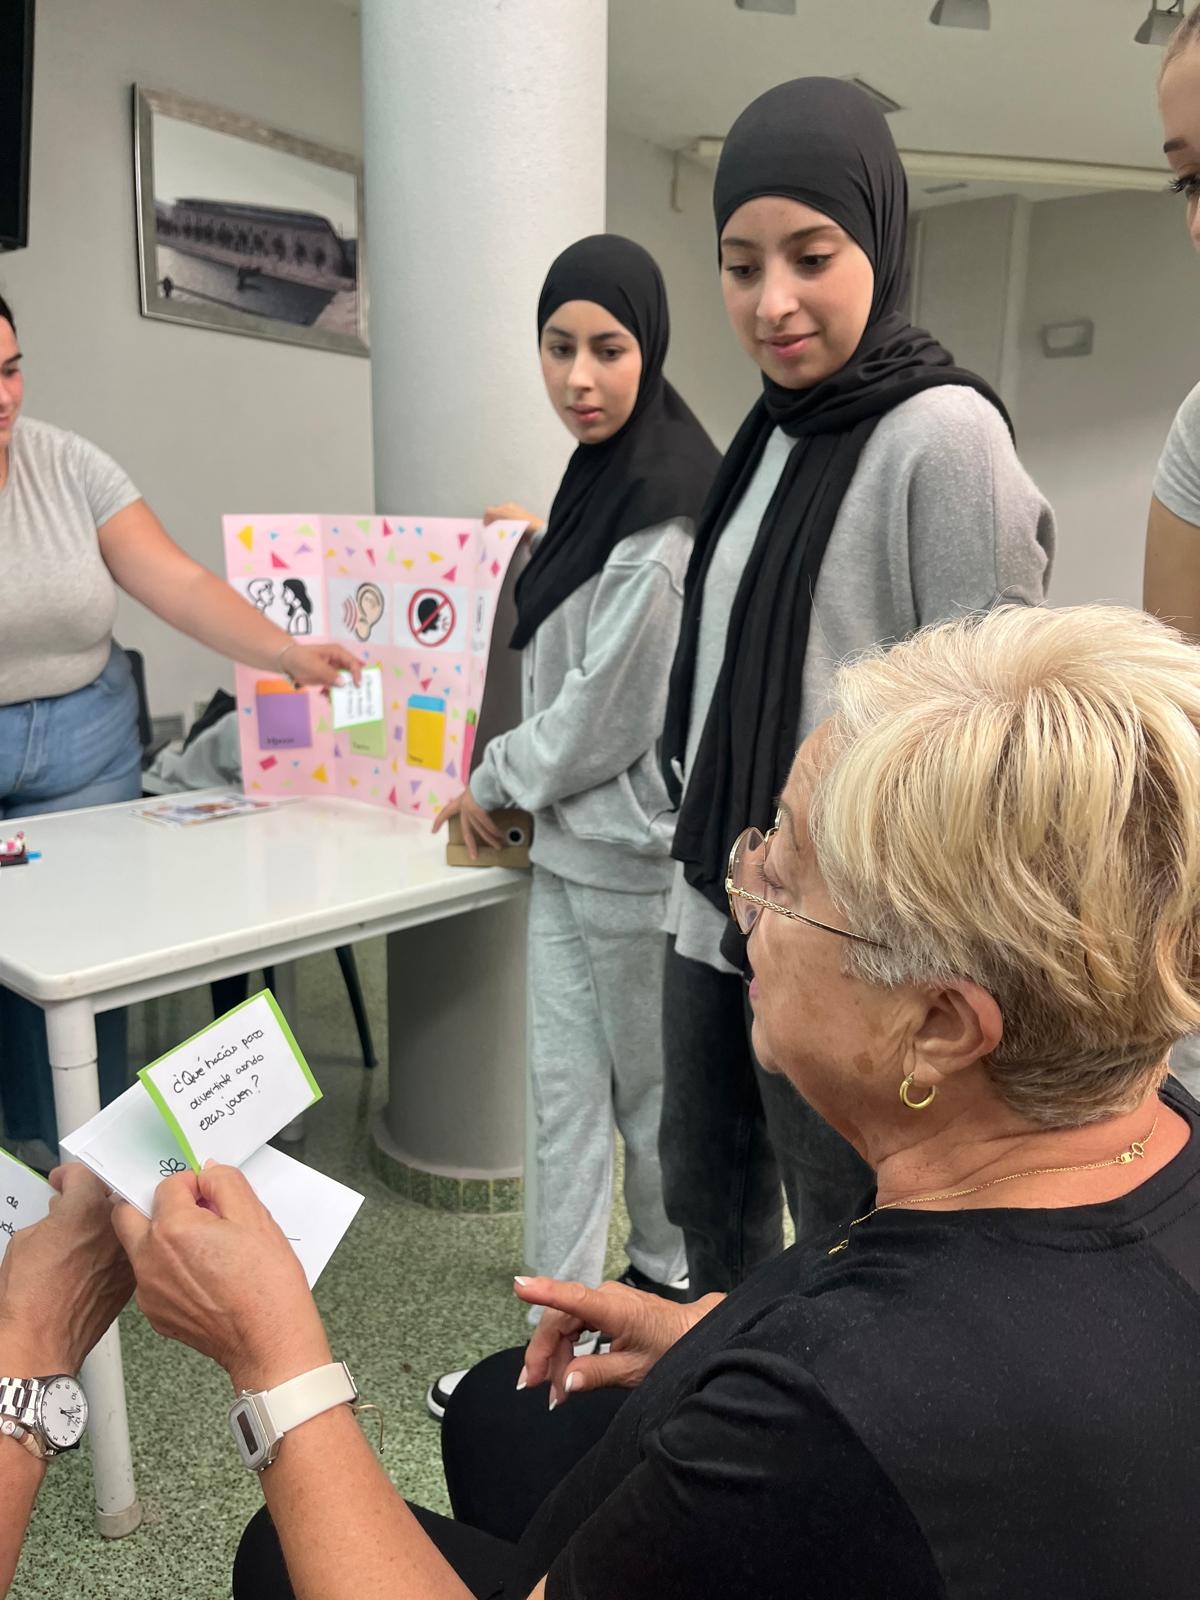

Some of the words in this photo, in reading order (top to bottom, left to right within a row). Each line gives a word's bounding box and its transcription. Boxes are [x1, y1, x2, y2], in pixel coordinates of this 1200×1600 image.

[173, 1056, 206, 1094] ¿Qué
[241, 1029, 265, 1050] para
[199, 1109, 226, 1131] eras
